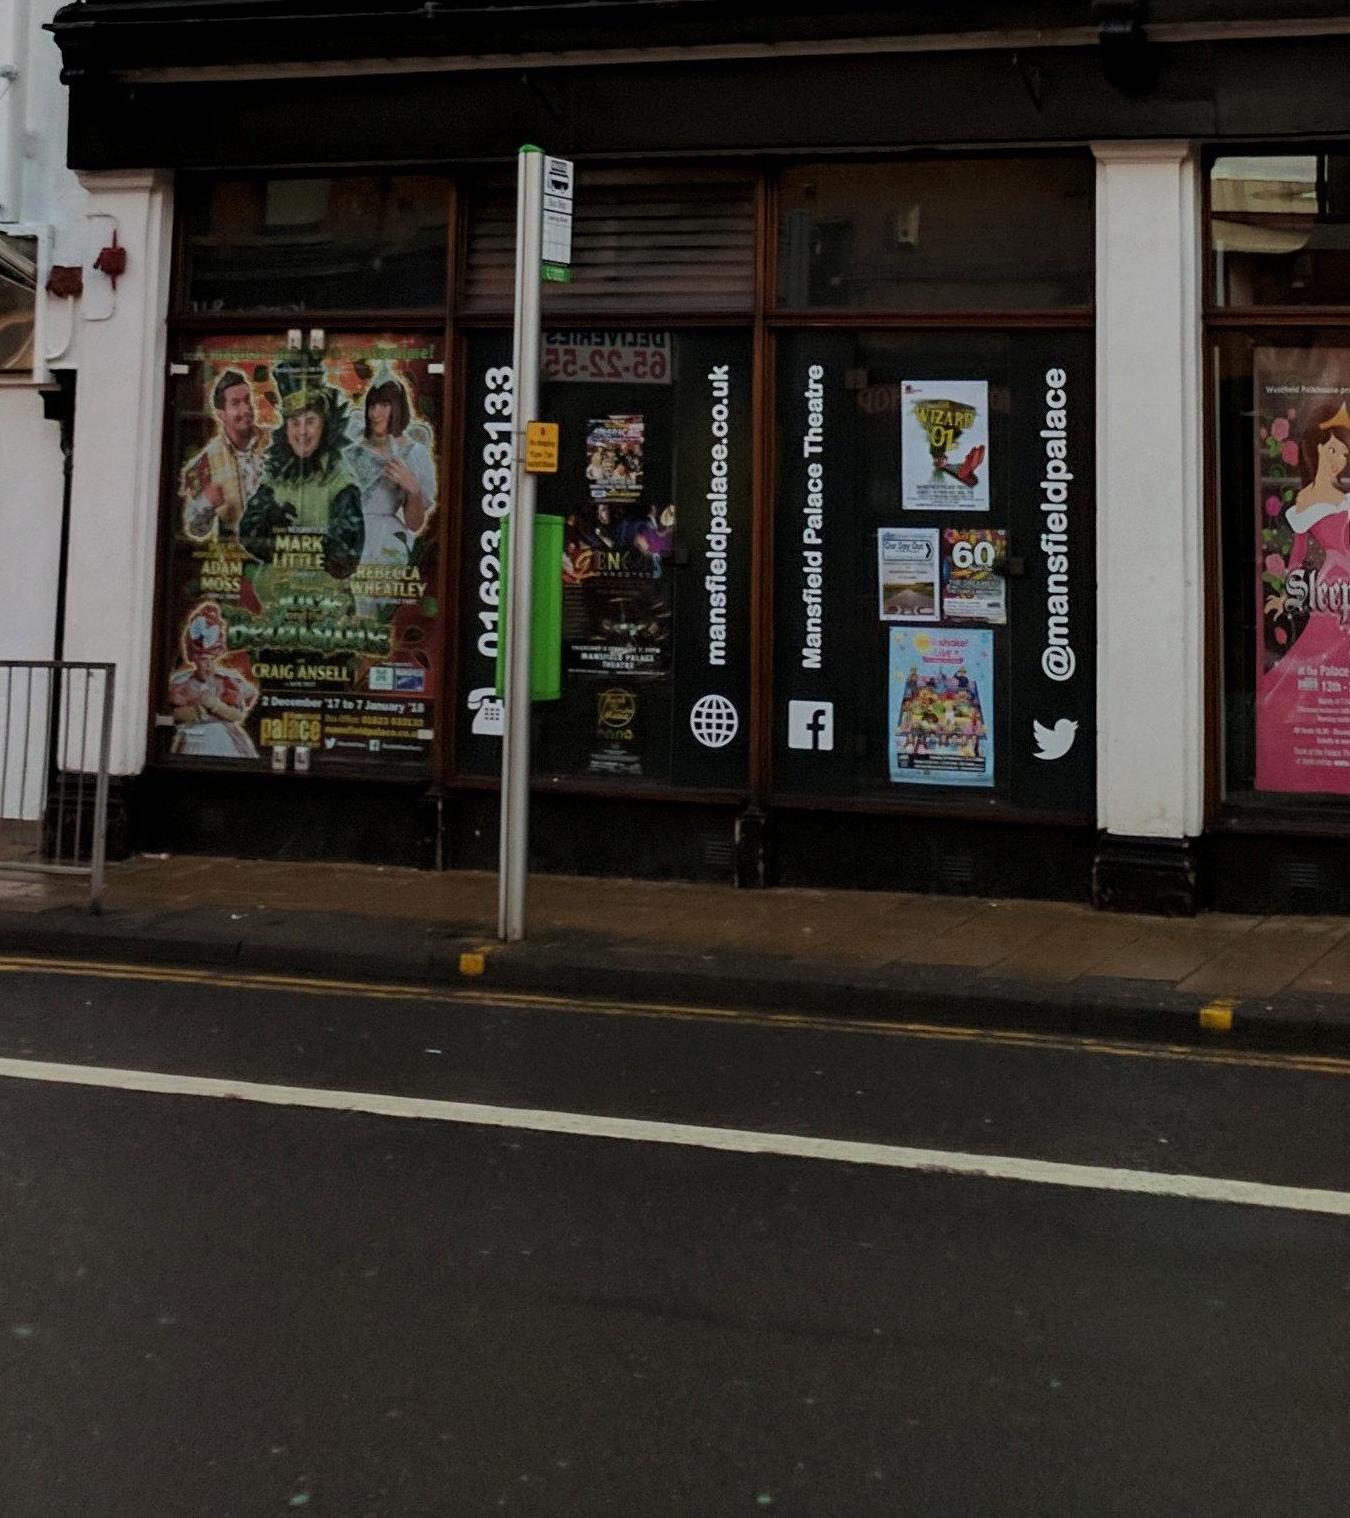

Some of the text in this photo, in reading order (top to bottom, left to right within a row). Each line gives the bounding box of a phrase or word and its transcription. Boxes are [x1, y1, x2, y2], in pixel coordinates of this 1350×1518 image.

[481, 366, 513, 519] 633133
[704, 364, 732, 666] mansfieldpalace.co.uk
[802, 364, 824, 669] Mansfield Palace Theatre
[1040, 367, 1076, 682] @mansfieldpalace
[275, 535, 323, 552] MARK
[272, 553, 325, 570] LITTLE
[952, 540, 996, 569] 60
[201, 561, 243, 576] ADAM
[200, 577, 241, 592] MOSS
[351, 582, 427, 598] WHEATLEY
[251, 663, 351, 682] CRAIG ANSELL
[1319, 665, 1349, 677] Palace
[1320, 681, 1342, 692] 13th
[261, 694, 268, 706] 2
[270, 695, 323, 708] December
[342, 698, 354, 709] to
[364, 700, 405, 714] January
